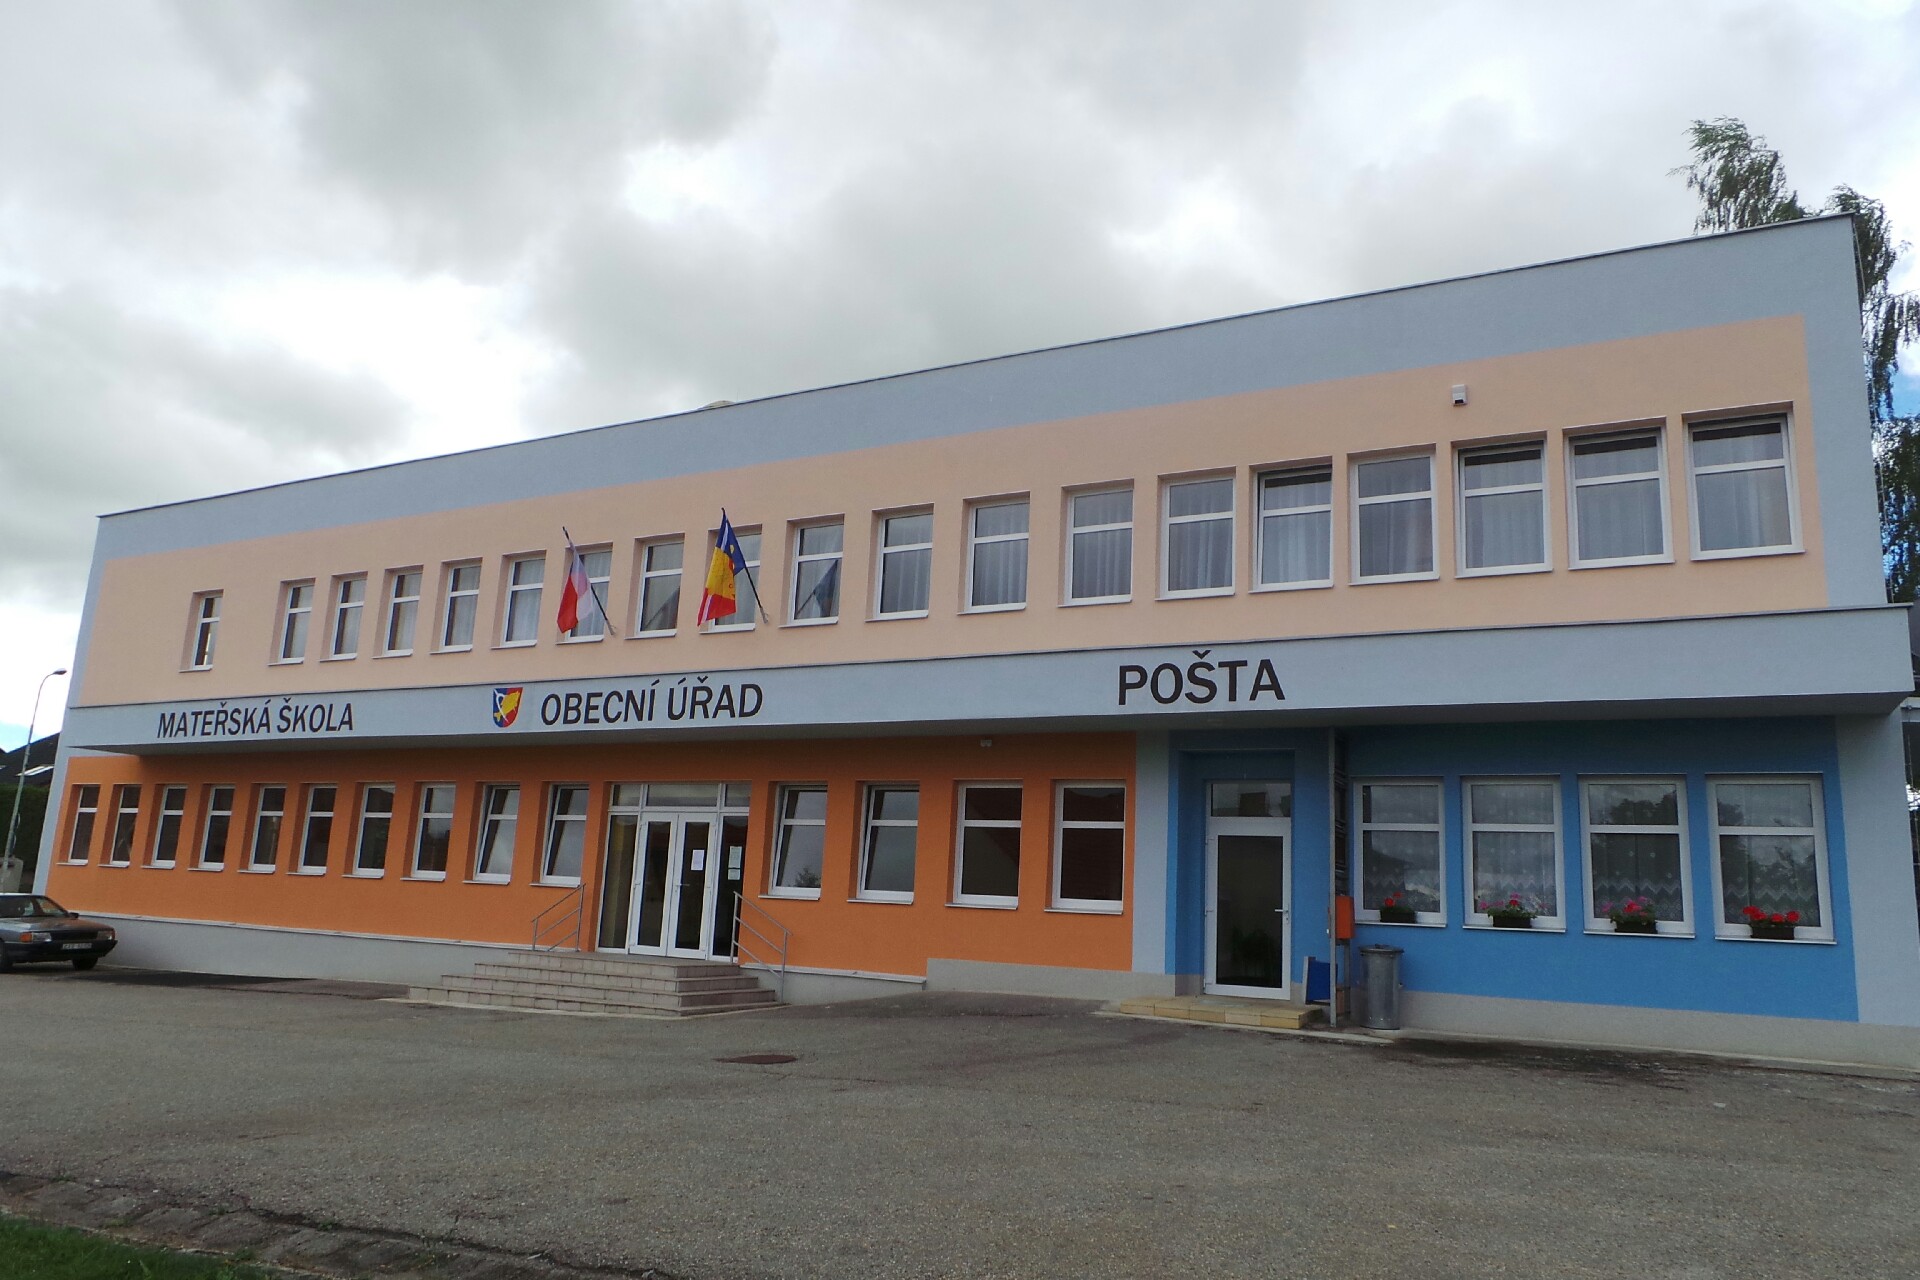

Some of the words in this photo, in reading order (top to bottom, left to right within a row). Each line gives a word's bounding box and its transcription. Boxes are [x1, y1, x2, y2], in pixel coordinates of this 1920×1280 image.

[541, 678, 660, 725] OBECNÍ
[667, 675, 763, 721] ÚŘAD
[1118, 649, 1286, 705] POŠTA
[156, 699, 271, 739] MATEŘSKÁ
[276, 697, 354, 734] ŠKOLA
